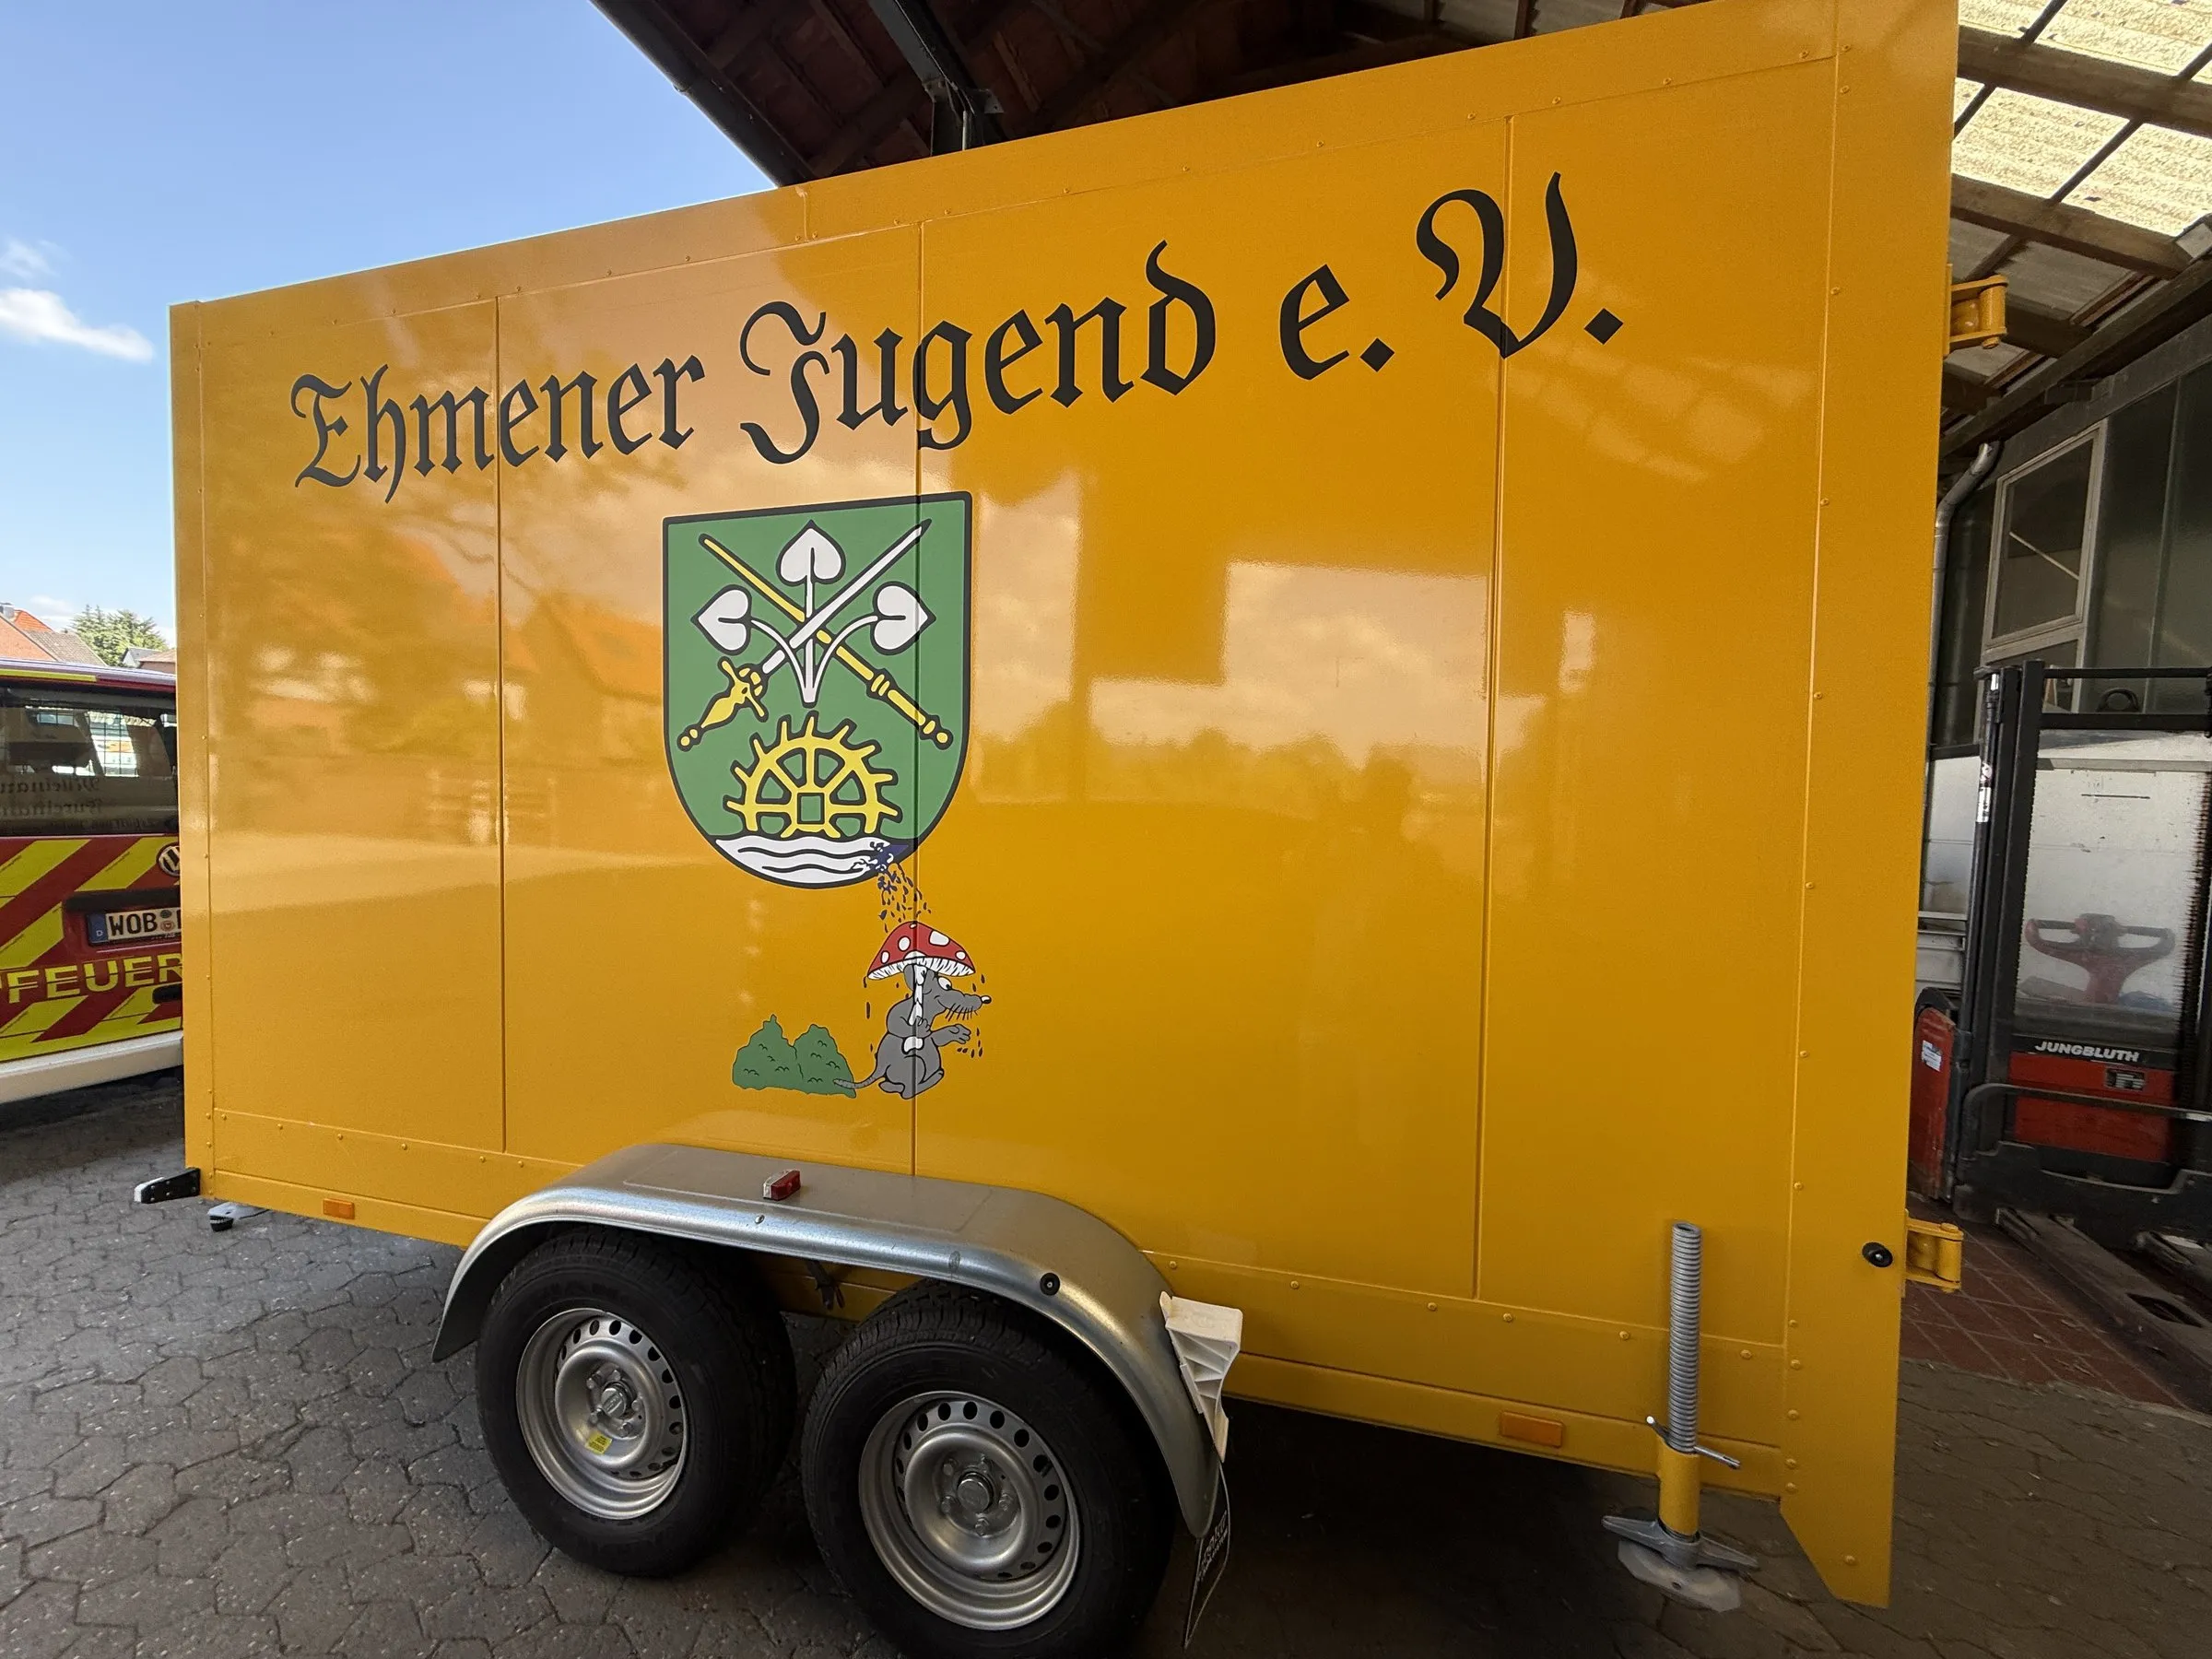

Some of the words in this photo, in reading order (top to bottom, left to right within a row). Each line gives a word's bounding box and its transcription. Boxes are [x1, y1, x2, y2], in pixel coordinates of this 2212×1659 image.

[290, 355, 706, 503] Ehmener
[739, 239, 1216, 465] Jugend
[1279, 264, 1394, 380] e.
[1416, 171, 1624, 359] V.
[109, 912, 158, 936] WOB
[2034, 1041, 2140, 1063] JUNGBLUTH
